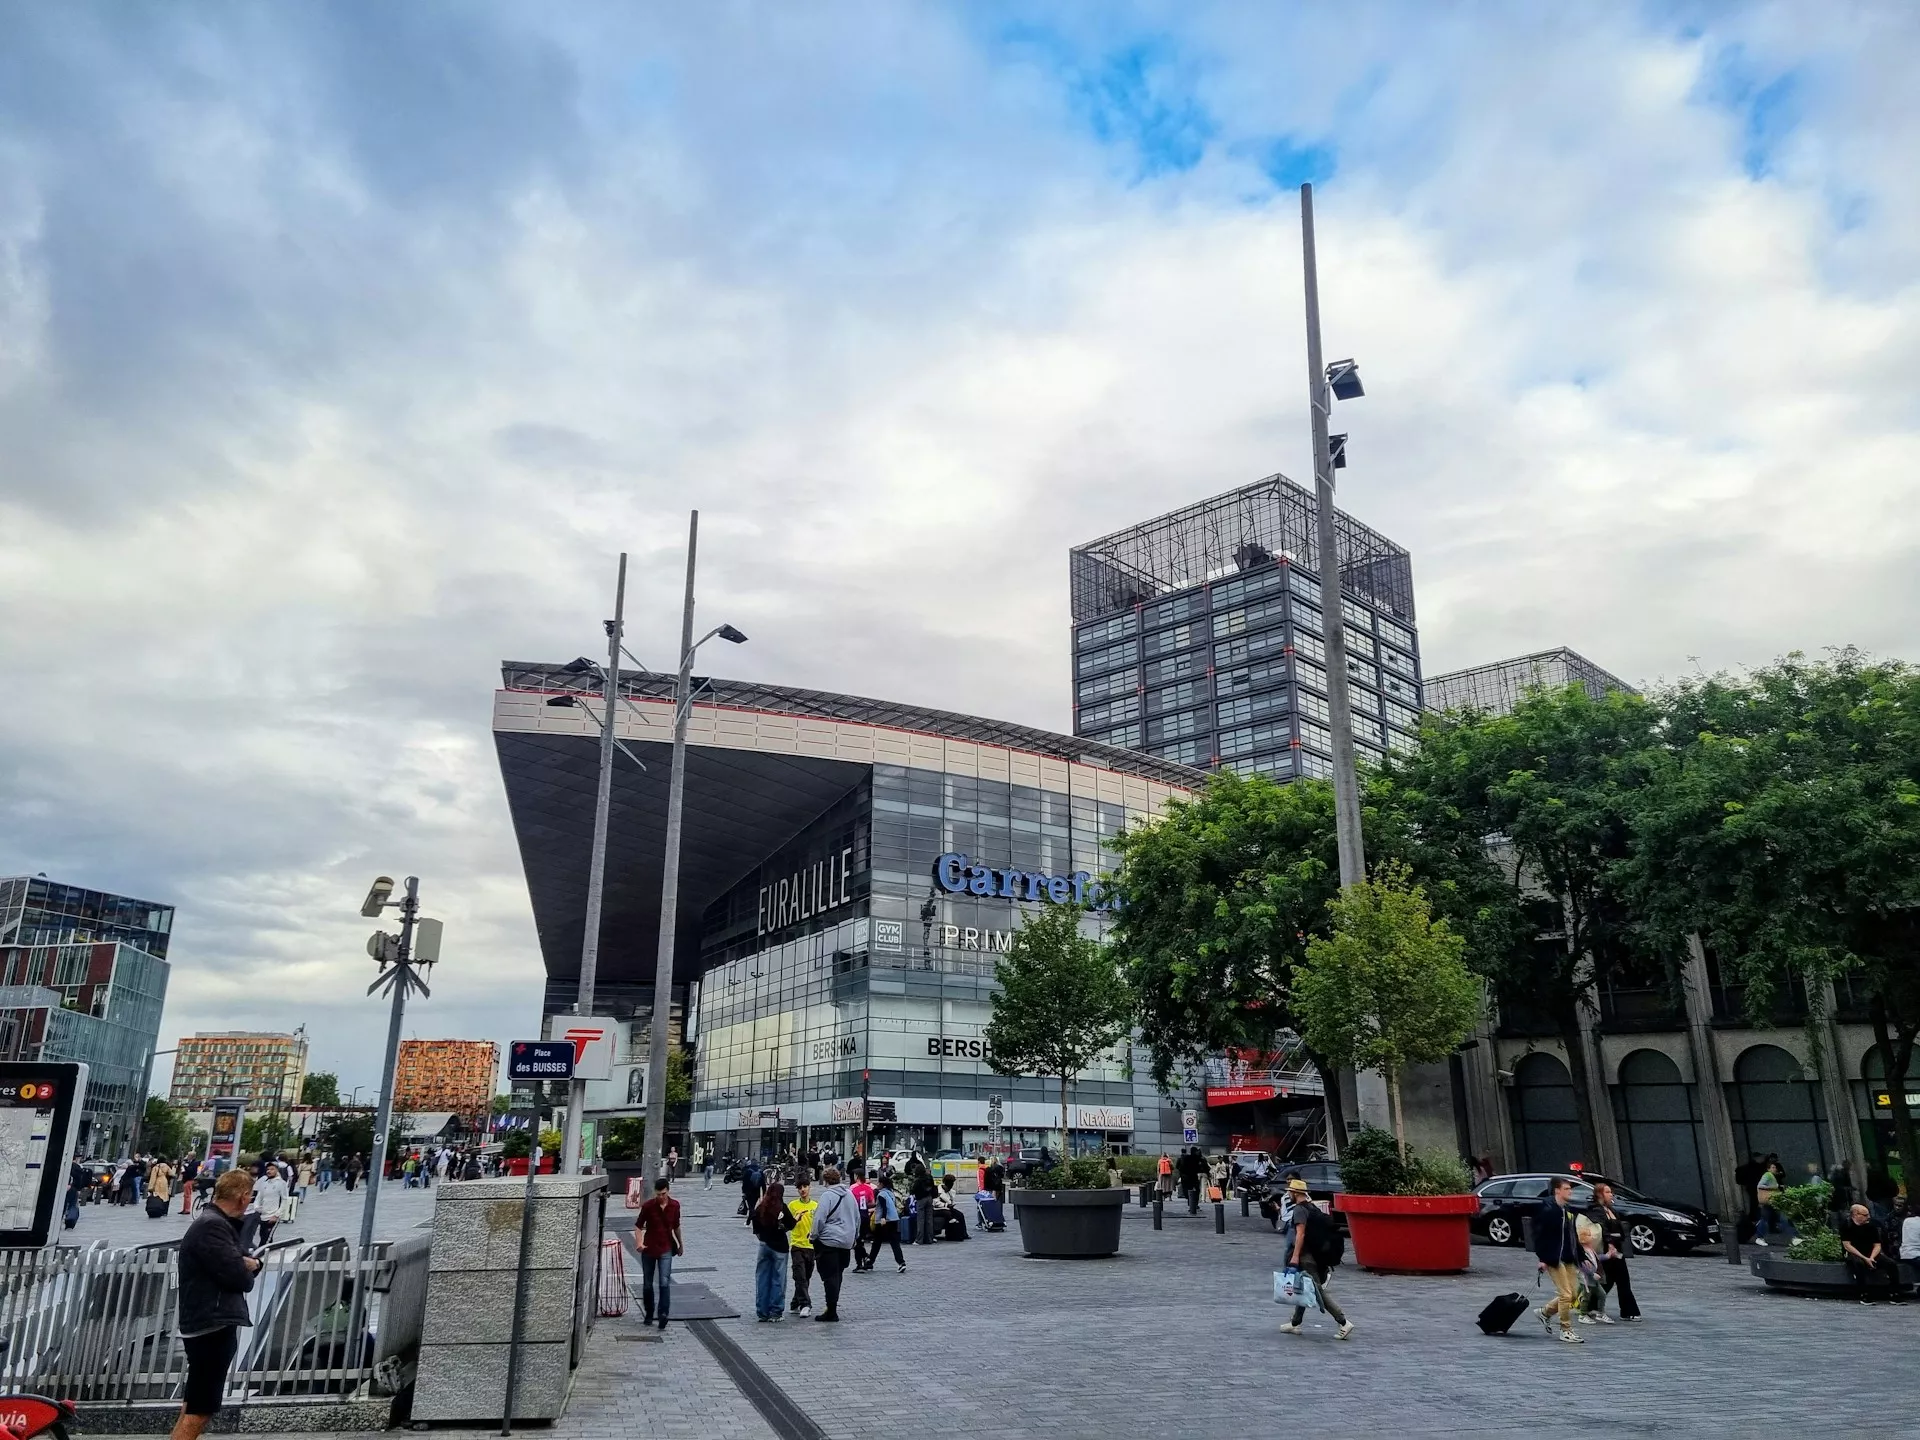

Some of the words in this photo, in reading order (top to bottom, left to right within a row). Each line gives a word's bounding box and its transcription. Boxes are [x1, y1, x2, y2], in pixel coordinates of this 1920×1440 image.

[757, 847, 852, 937] EURALILLE
[937, 852, 1122, 912] Carrefo
[878, 935, 900, 943] CLUB
[944, 925, 1013, 952] PRIM
[534, 1049, 552, 1057] Place
[813, 1036, 857, 1060] BERSHKA
[927, 1037, 993, 1058] BERSH
[516, 1062, 531, 1072] des
[532, 1062, 567, 1073] BUISSES
